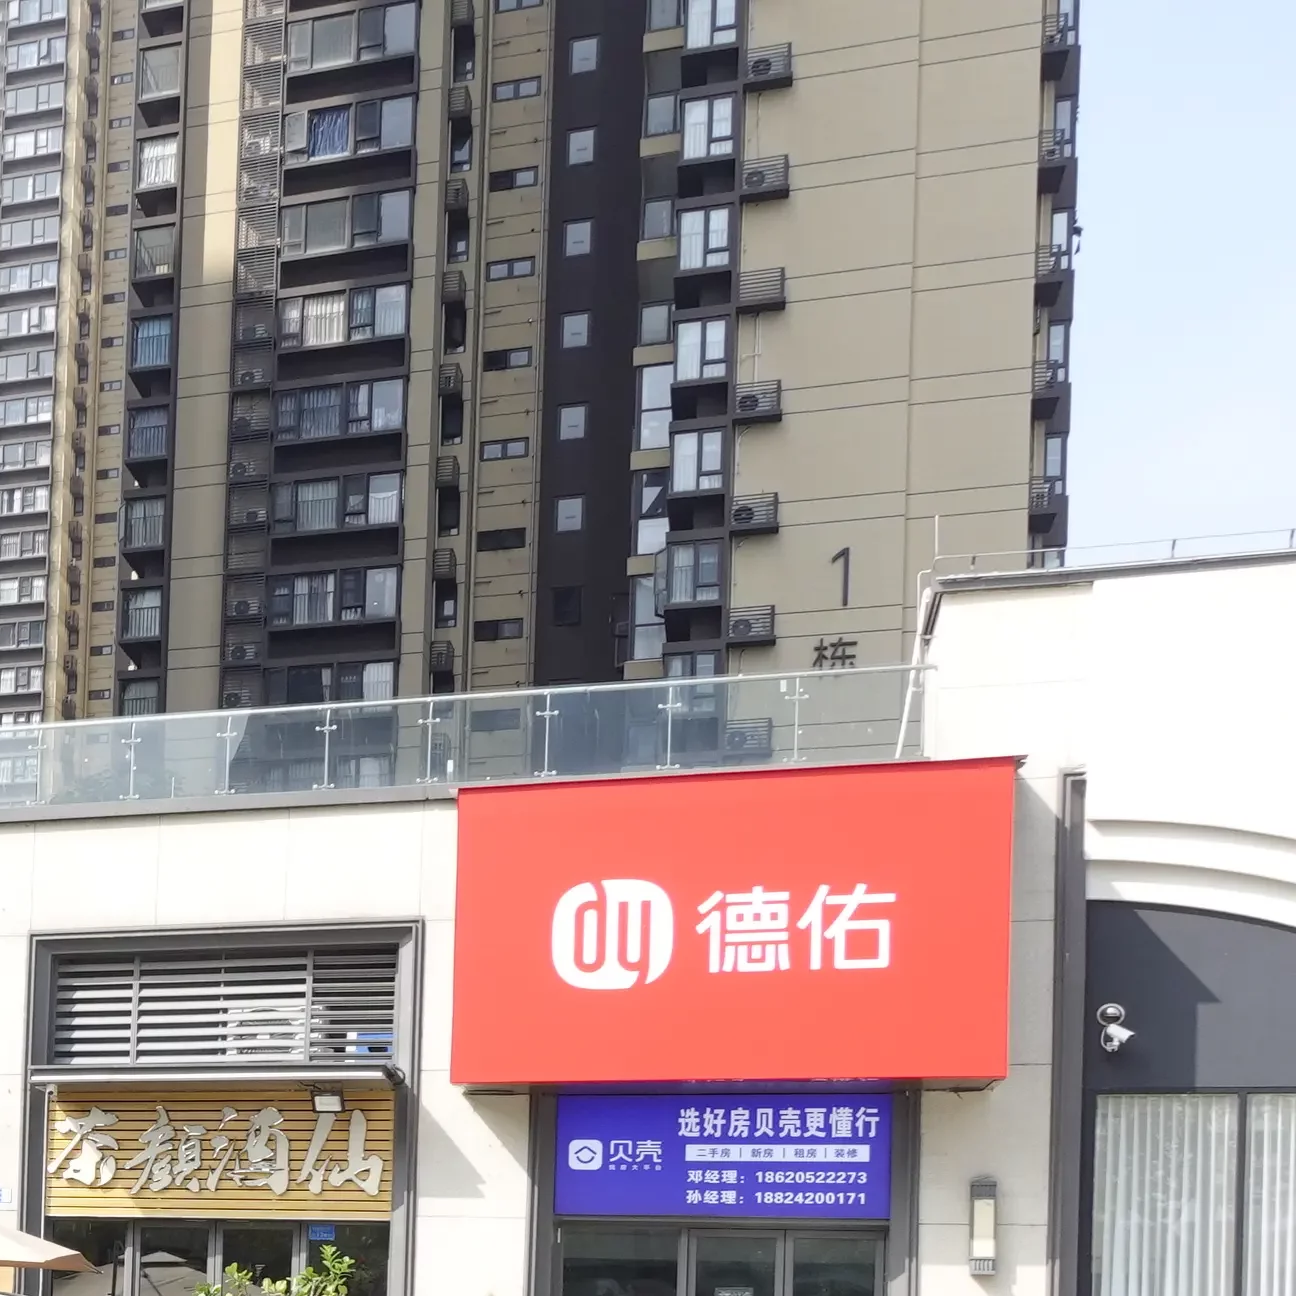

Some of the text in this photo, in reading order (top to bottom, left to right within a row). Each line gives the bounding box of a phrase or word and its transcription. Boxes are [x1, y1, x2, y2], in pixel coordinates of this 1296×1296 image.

[696, 883, 896, 974] 德佑
[678, 1107, 880, 1138] 选好房贝壳更懂行
[609, 1139, 663, 1163] 贝壳
[755, 1172, 868, 1184] 18620522273
[754, 1192, 866, 1204] 18824200171
